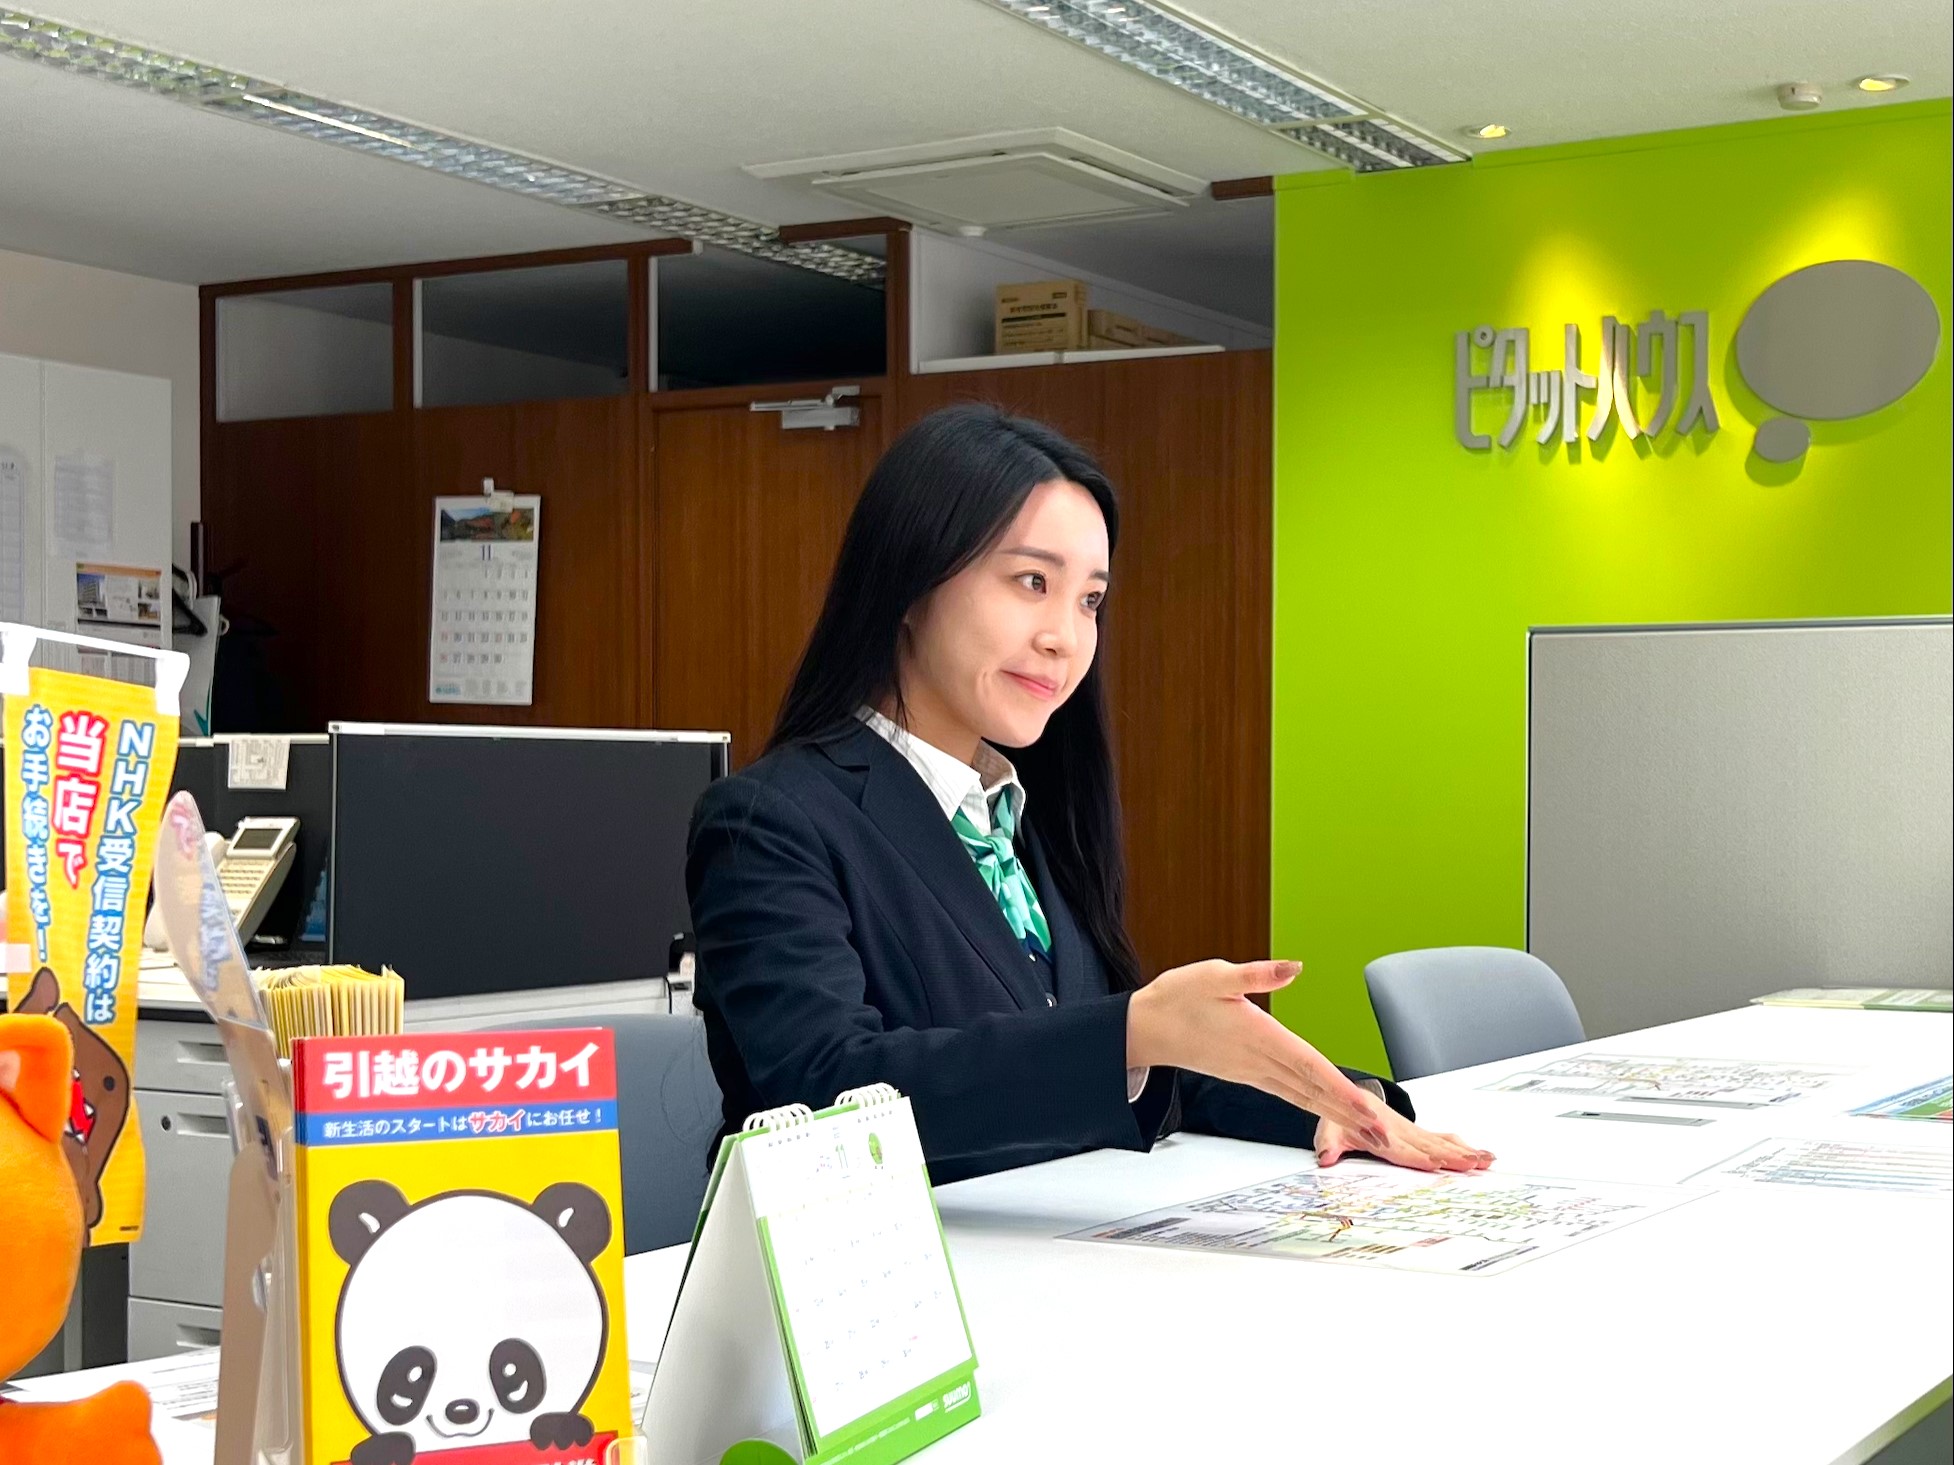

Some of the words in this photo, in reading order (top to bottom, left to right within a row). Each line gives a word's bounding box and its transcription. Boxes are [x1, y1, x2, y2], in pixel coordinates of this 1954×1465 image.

[1455, 310, 1720, 449] ピタットハウス
[52, 711, 108, 889] 当店で
[83, 720, 154, 1024] NHK受信契約は
[321, 1042, 601, 1099] 引越のサカイ
